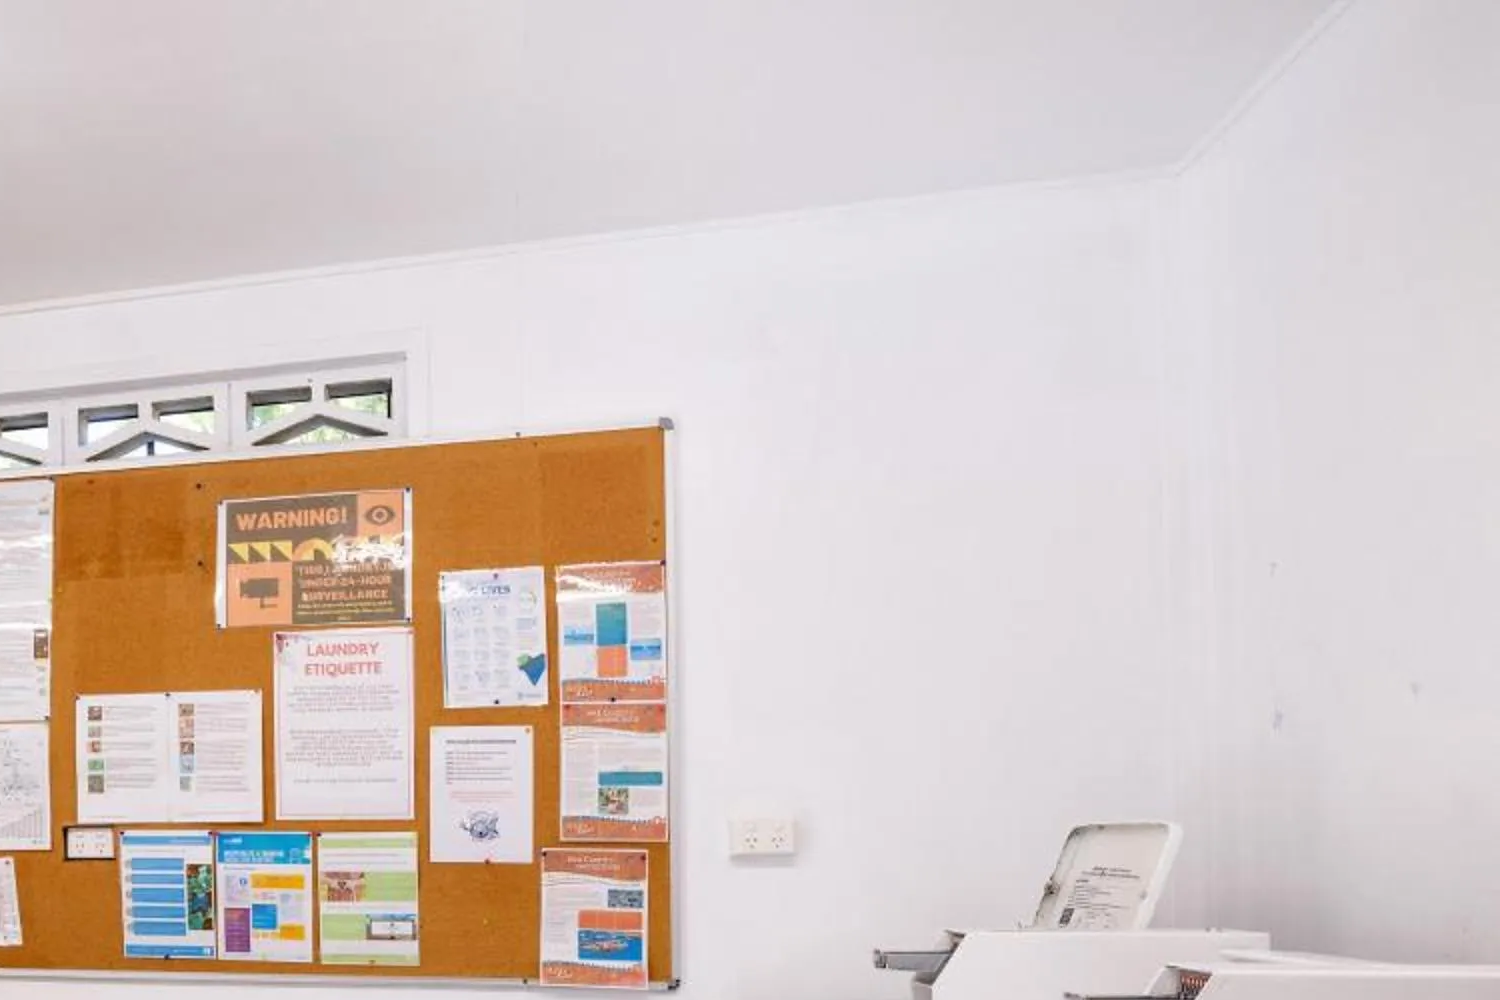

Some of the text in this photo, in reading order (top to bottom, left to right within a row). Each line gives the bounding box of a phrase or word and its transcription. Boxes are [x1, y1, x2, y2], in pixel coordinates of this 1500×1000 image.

[235, 506, 348, 531] WARNING!
[301, 588, 389, 601] SURVEILLANCE
[307, 642, 380, 657] LAUNDRY
[304, 661, 384, 677] ETIQUETTE
